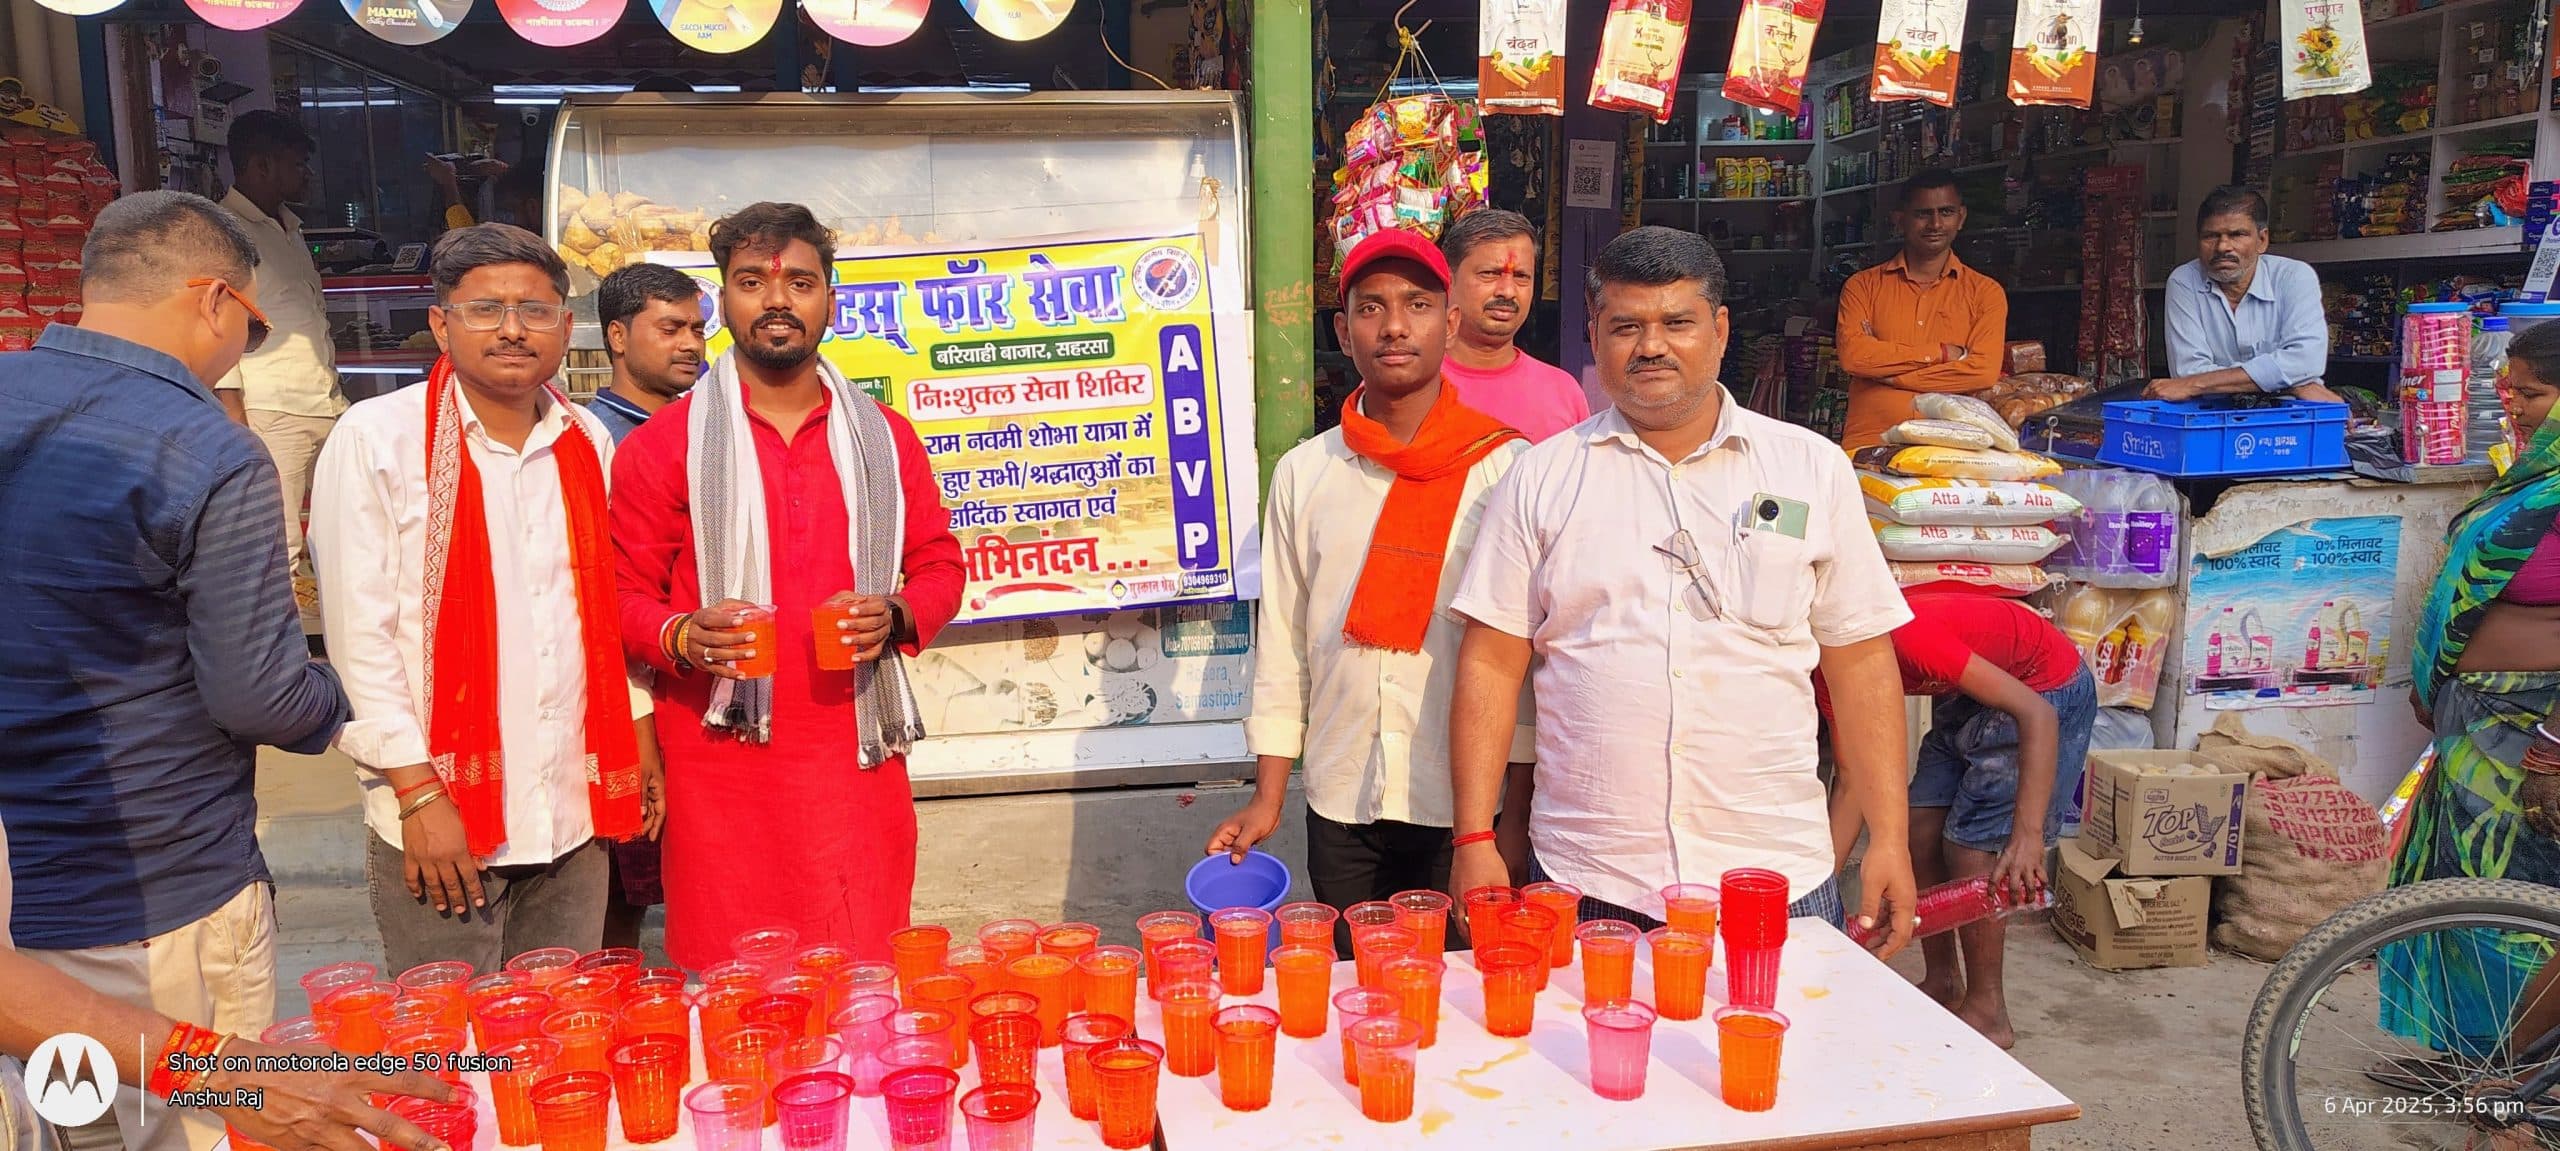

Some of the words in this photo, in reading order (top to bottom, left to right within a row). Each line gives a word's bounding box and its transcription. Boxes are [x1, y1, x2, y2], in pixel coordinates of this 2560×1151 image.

[1505, 36, 1539, 51] चंदन
[915, 258, 1012, 331] फॉर
[1022, 253, 1122, 322] सेवा
[936, 343, 997, 365] बरियाही
[1000, 342, 1052, 361] बाजार,
[1055, 338, 1110, 357] सहरसा
[1022, 376, 1070, 402] सेवा
[1077, 371, 1145, 398] शिविर
[924, 433, 961, 455] राम
[966, 422, 1023, 452] नवमी
[1028, 421, 1078, 447] शोभा
[1084, 419, 1128, 442] यात्रा
[1132, 413, 1153, 439] में
[942, 471, 971, 498] हुए
[1127, 456, 1156, 476] का
[950, 501, 1007, 528] हार्दिक
[1012, 498, 1081, 522] स्वागत
[1085, 489, 1118, 518] एवं
[1931, 492, 1960, 505] Atta
[2024, 493, 2053, 508] Atta
[1920, 525, 1949, 539] Atta
[2011, 528, 2040, 541] Atta
[2337, 534, 2383, 550] मिलावट
[2209, 558, 2247, 571] 100%
[2249, 554, 2281, 569] स्वाद
[2311, 552, 2348, 565] 100%
[2350, 550, 2383, 564] स्वाद
[1175, 687, 1243, 711] Samastipur
[2143, 804, 2196, 839] TOP
